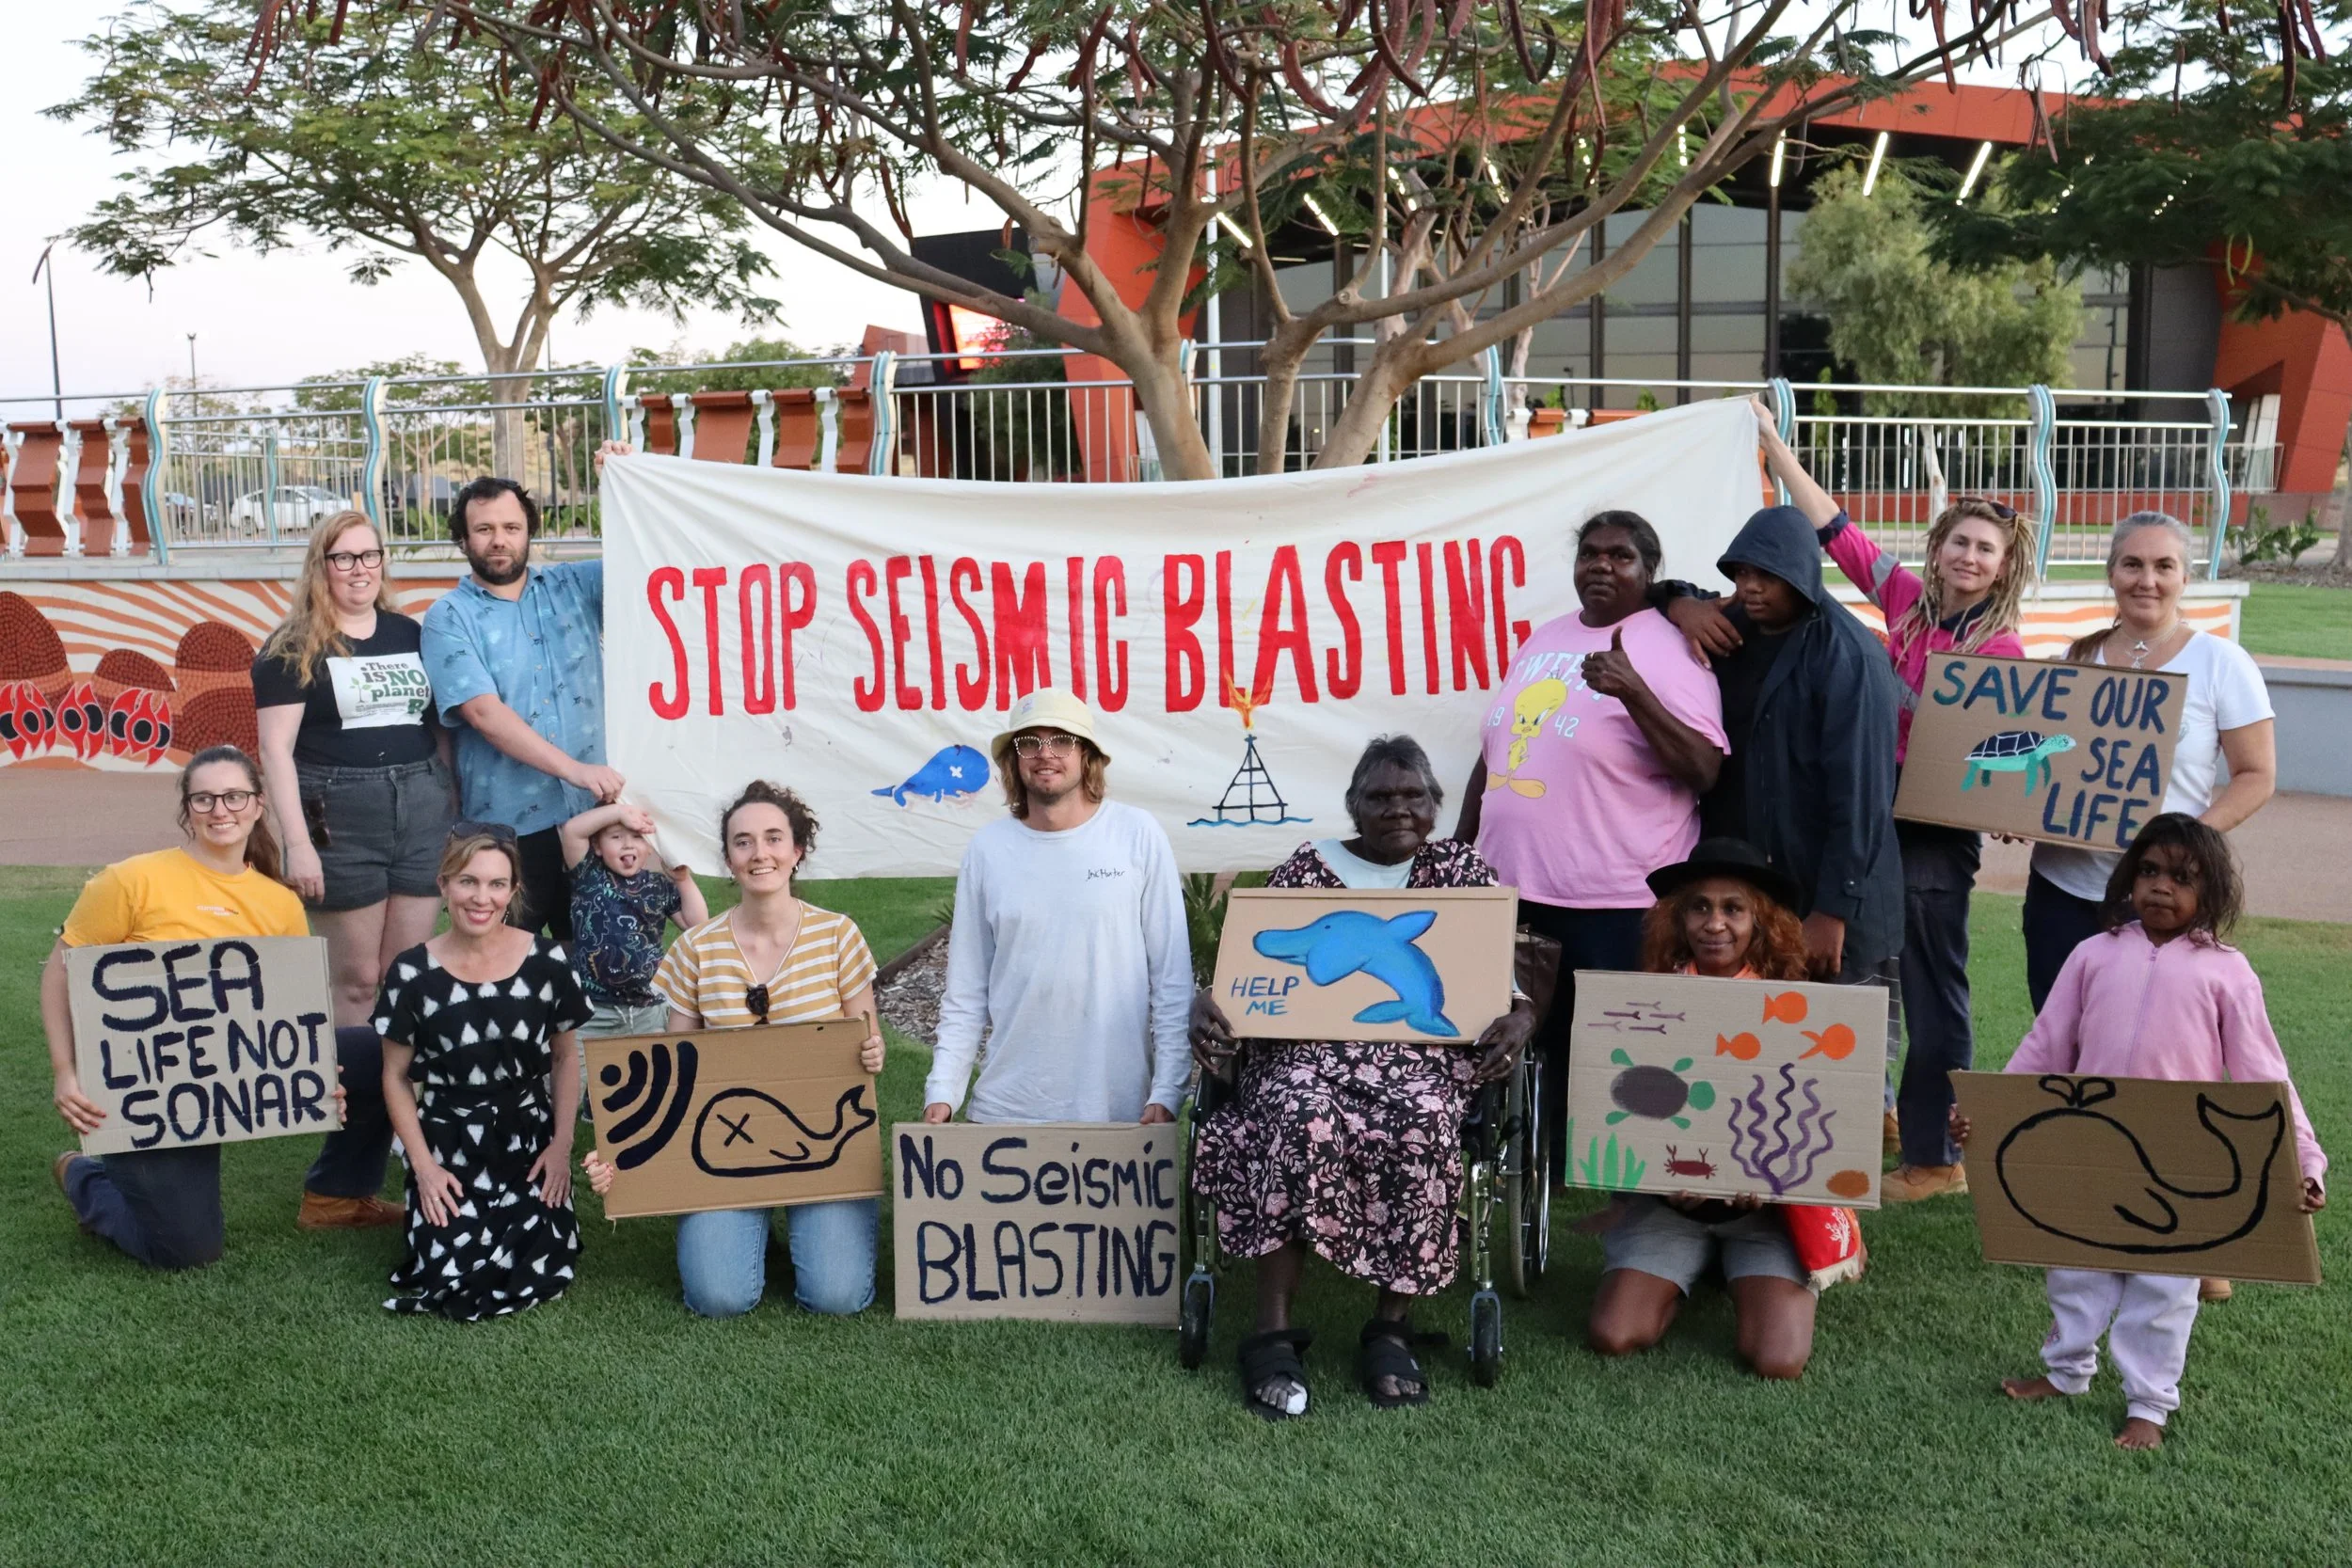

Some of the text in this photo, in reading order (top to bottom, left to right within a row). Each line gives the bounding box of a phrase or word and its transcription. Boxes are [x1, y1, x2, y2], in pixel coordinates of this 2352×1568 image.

[646, 534, 1533, 721] STOP SEISMIC BLASTING
[364, 661, 410, 672] There
[371, 684, 431, 703] planet
[386, 669, 427, 687] NO
[1932, 660, 2169, 734] SAVE OUR
[1554, 715, 1580, 738] 42
[2080, 736, 2161, 797] SEA
[2042, 782, 2149, 848] LIFE
[91, 940, 264, 1032] SEA
[1231, 975, 1300, 998] HELP
[1245, 999, 1288, 1016] ME
[100, 1012, 327, 1090] LIFE NOT
[120, 1069, 327, 1149] SONAR
[899, 1132, 964, 1200] No
[916, 1219, 1178, 1305] BLASTING
